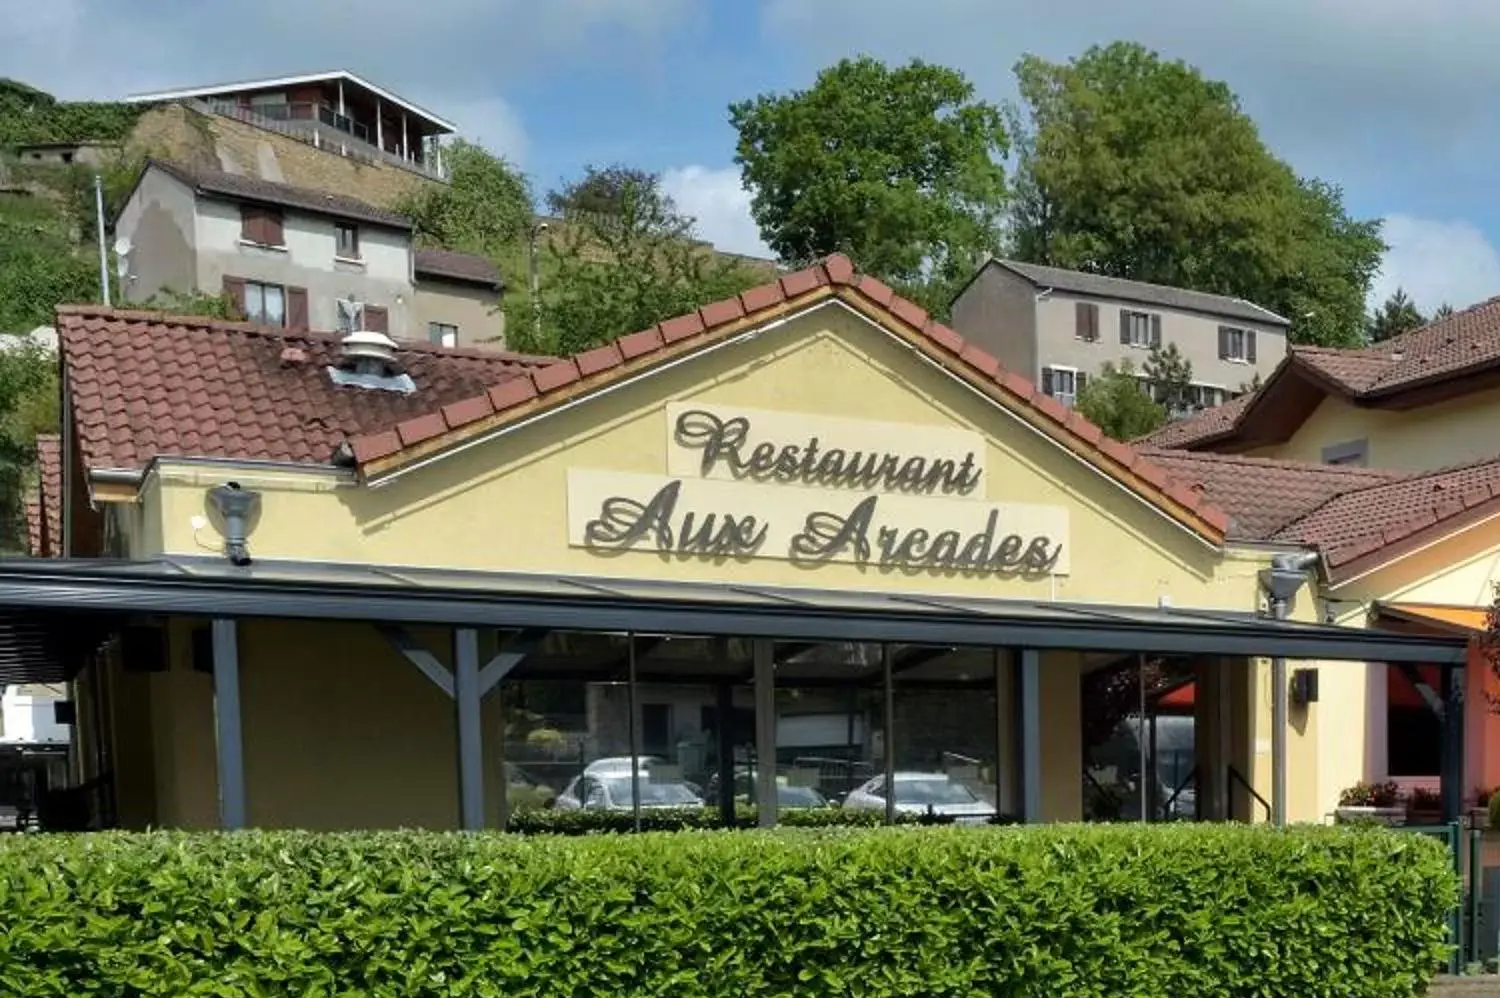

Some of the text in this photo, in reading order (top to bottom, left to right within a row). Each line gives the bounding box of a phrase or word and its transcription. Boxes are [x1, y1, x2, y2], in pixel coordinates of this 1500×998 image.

[676, 410, 982, 494] Restaurant
[586, 480, 1062, 577] Aux Arcades
